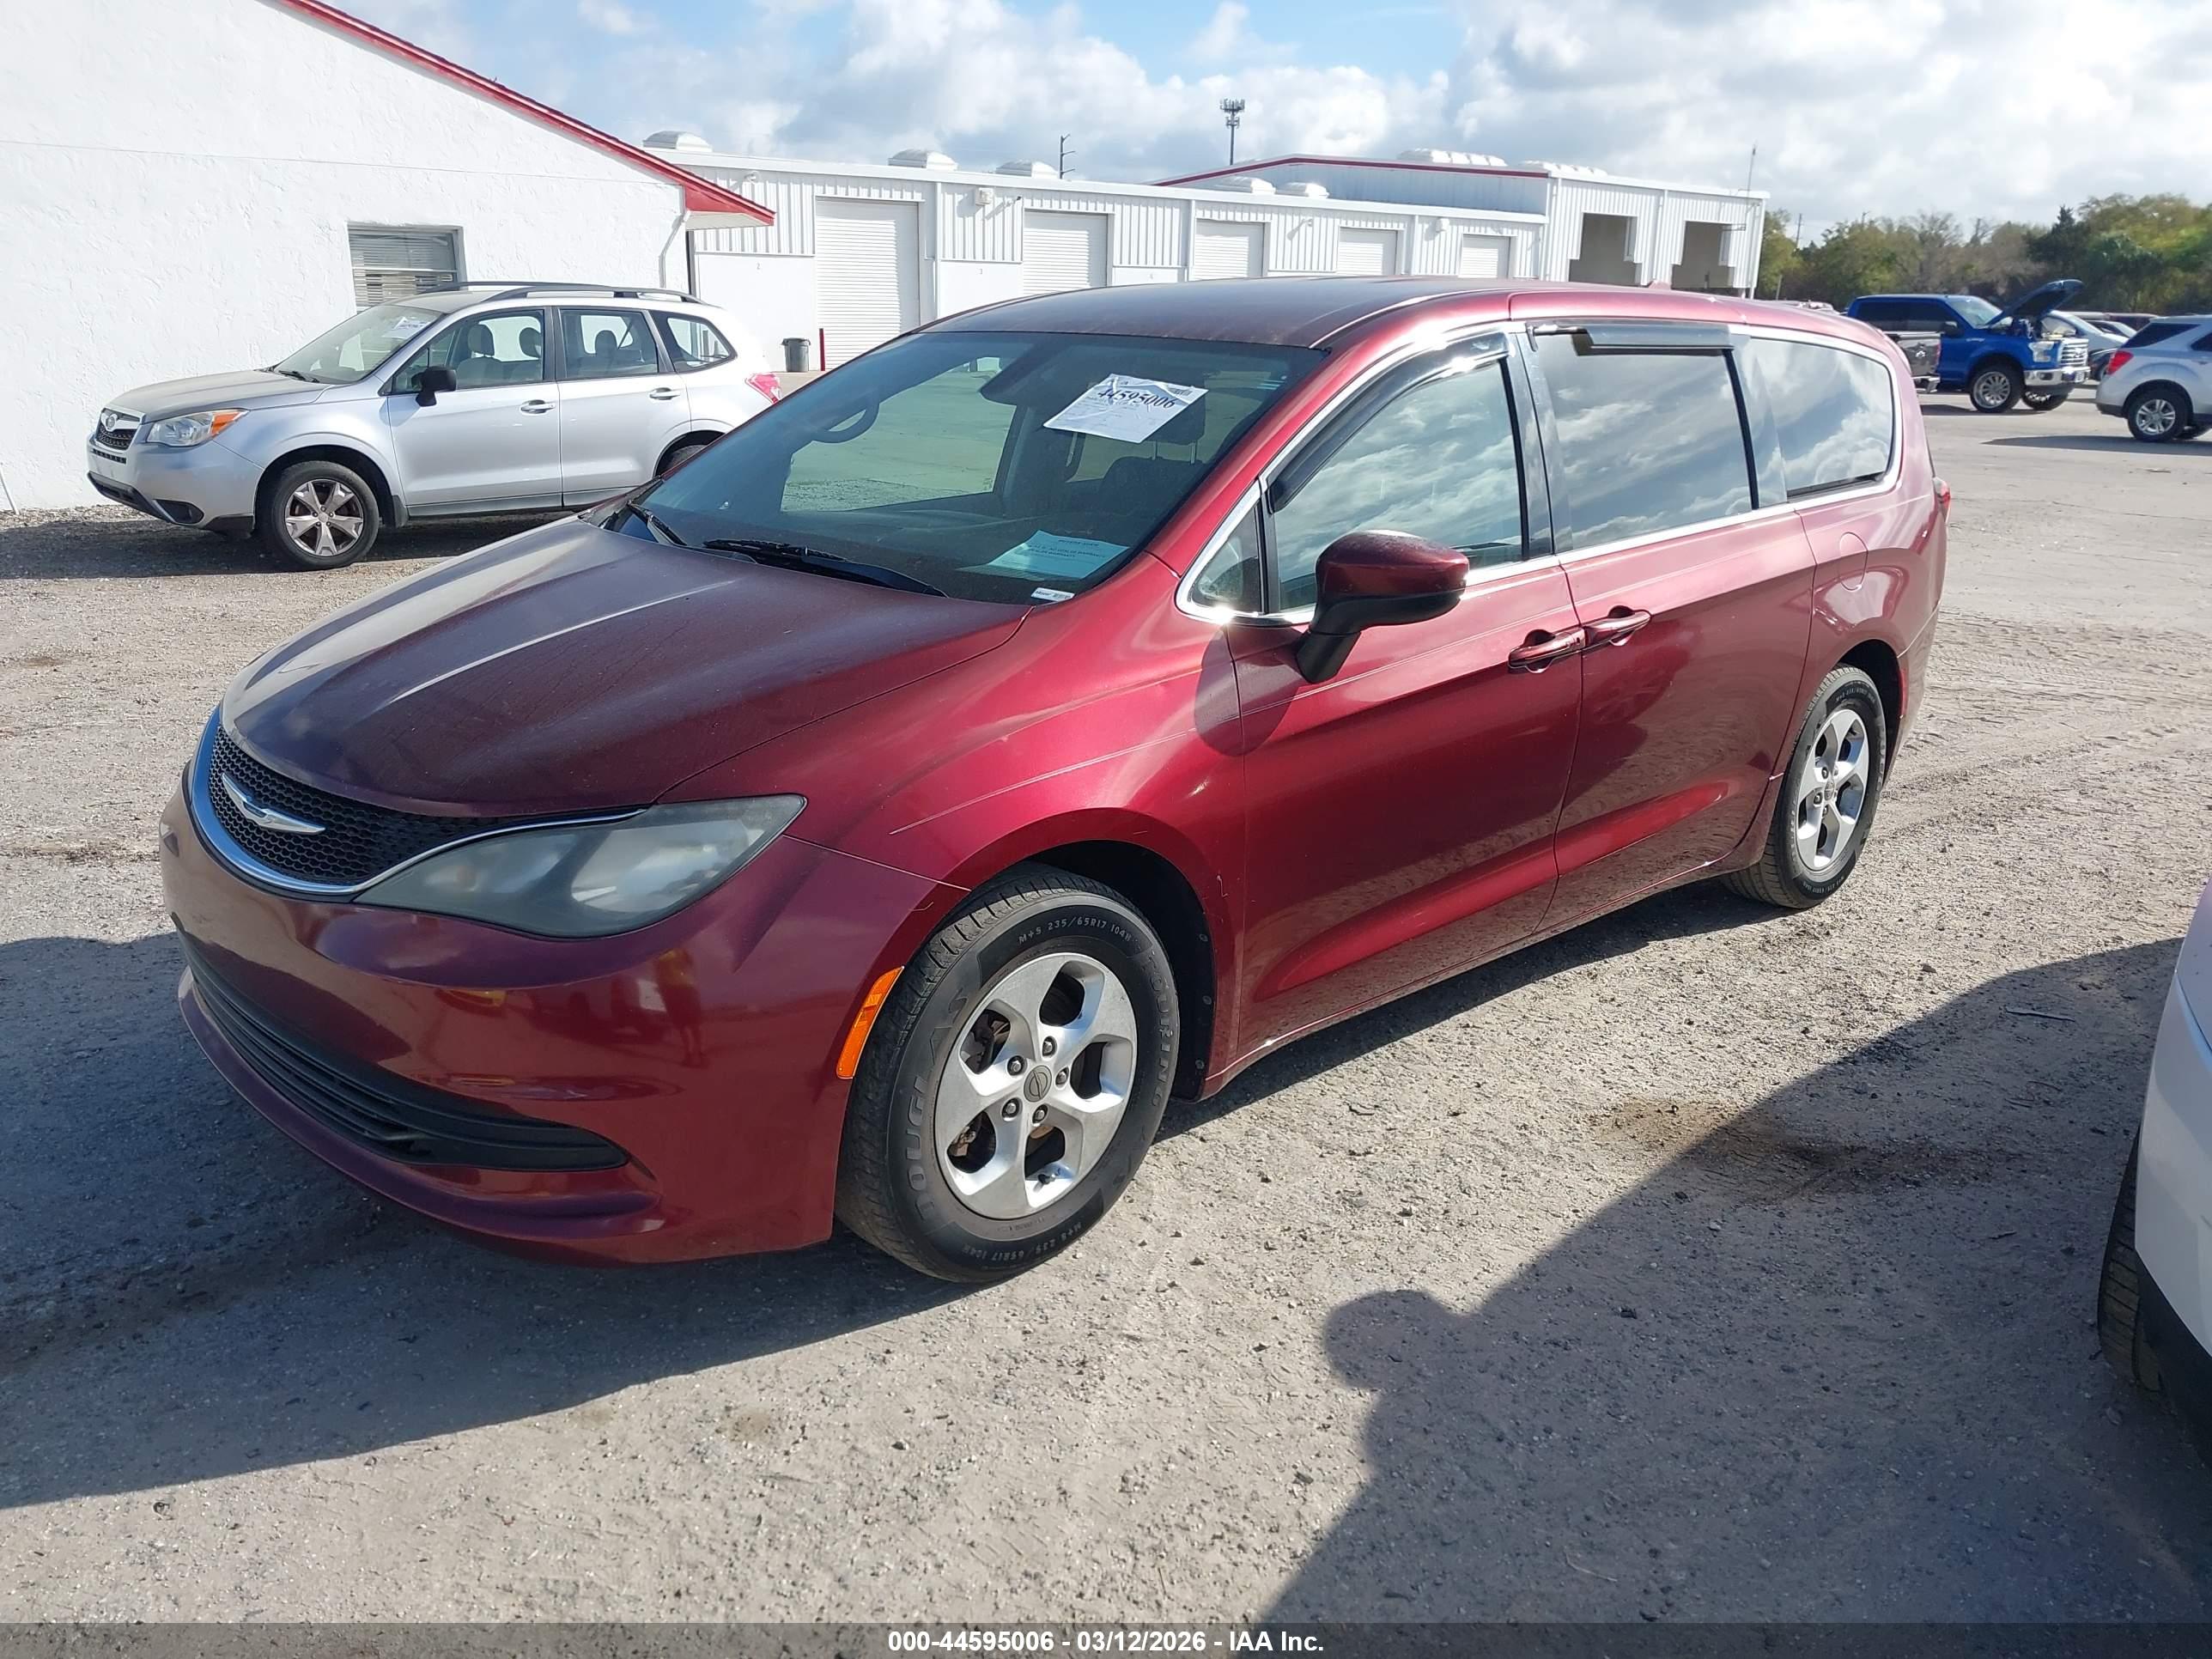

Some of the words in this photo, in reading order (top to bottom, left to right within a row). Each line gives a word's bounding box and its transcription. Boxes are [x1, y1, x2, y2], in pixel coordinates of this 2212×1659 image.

[1098, 388, 1176, 409] 44595006
[1018, 927, 1042, 945] M+S
[1048, 916, 1108, 931] 235/65R17
[1141, 949, 1171, 1107] TOURING
[906, 987, 969, 1221] DOUGLAS
